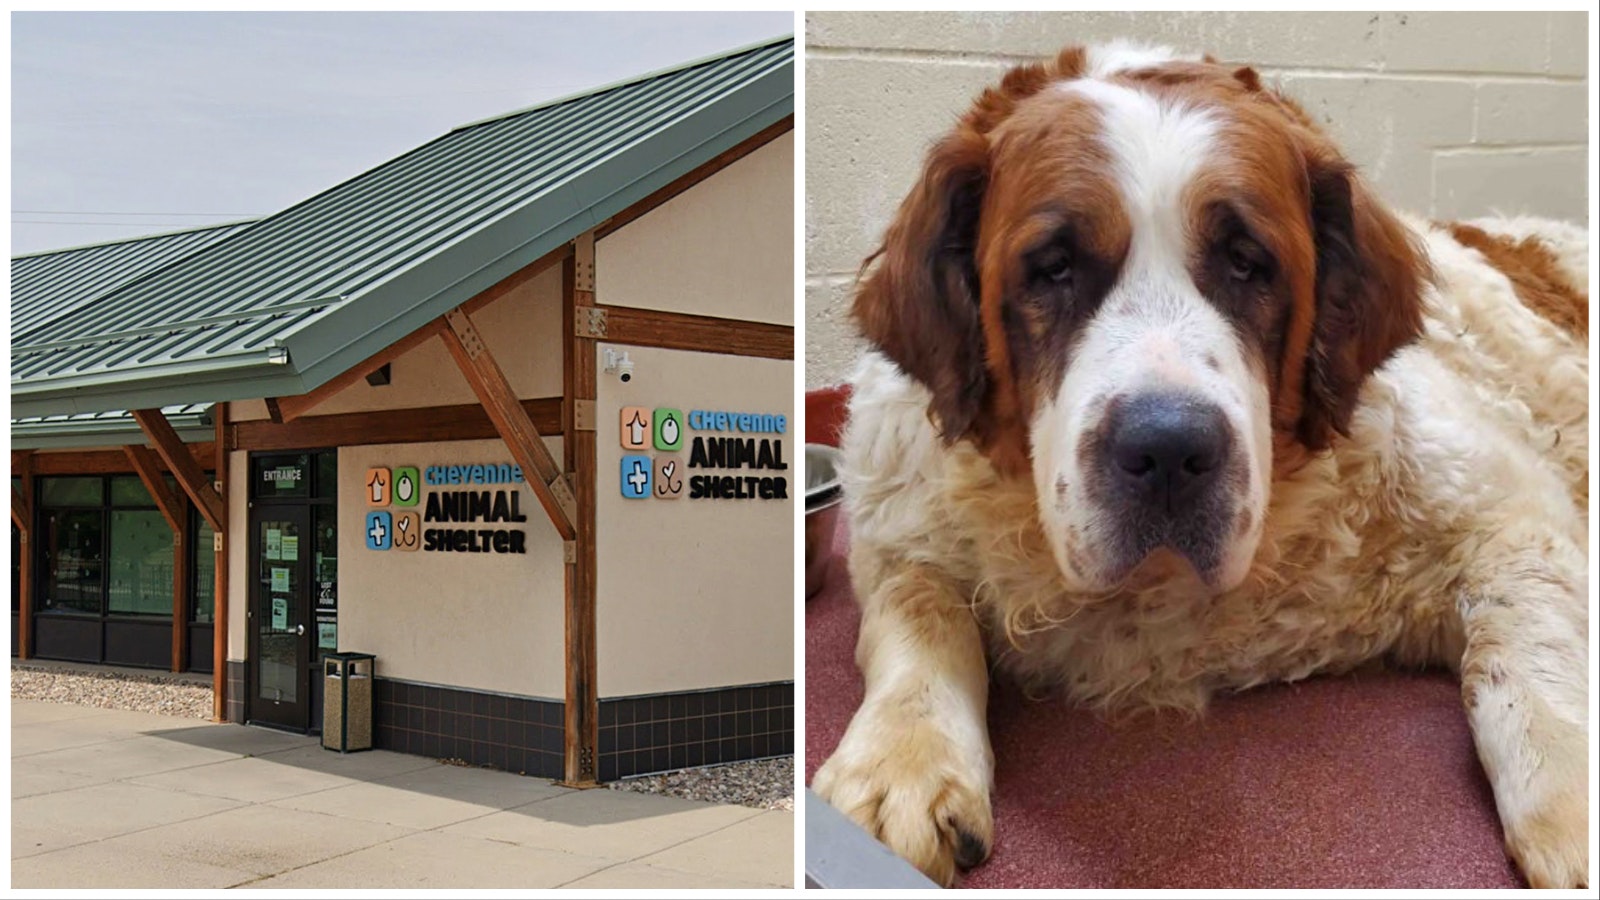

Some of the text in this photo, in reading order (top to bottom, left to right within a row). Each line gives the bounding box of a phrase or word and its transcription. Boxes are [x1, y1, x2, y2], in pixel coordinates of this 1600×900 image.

[688, 436, 788, 470] ANIMAL
[263, 469, 302, 481] ENTRANCE
[424, 490, 527, 523] ANIMAL
